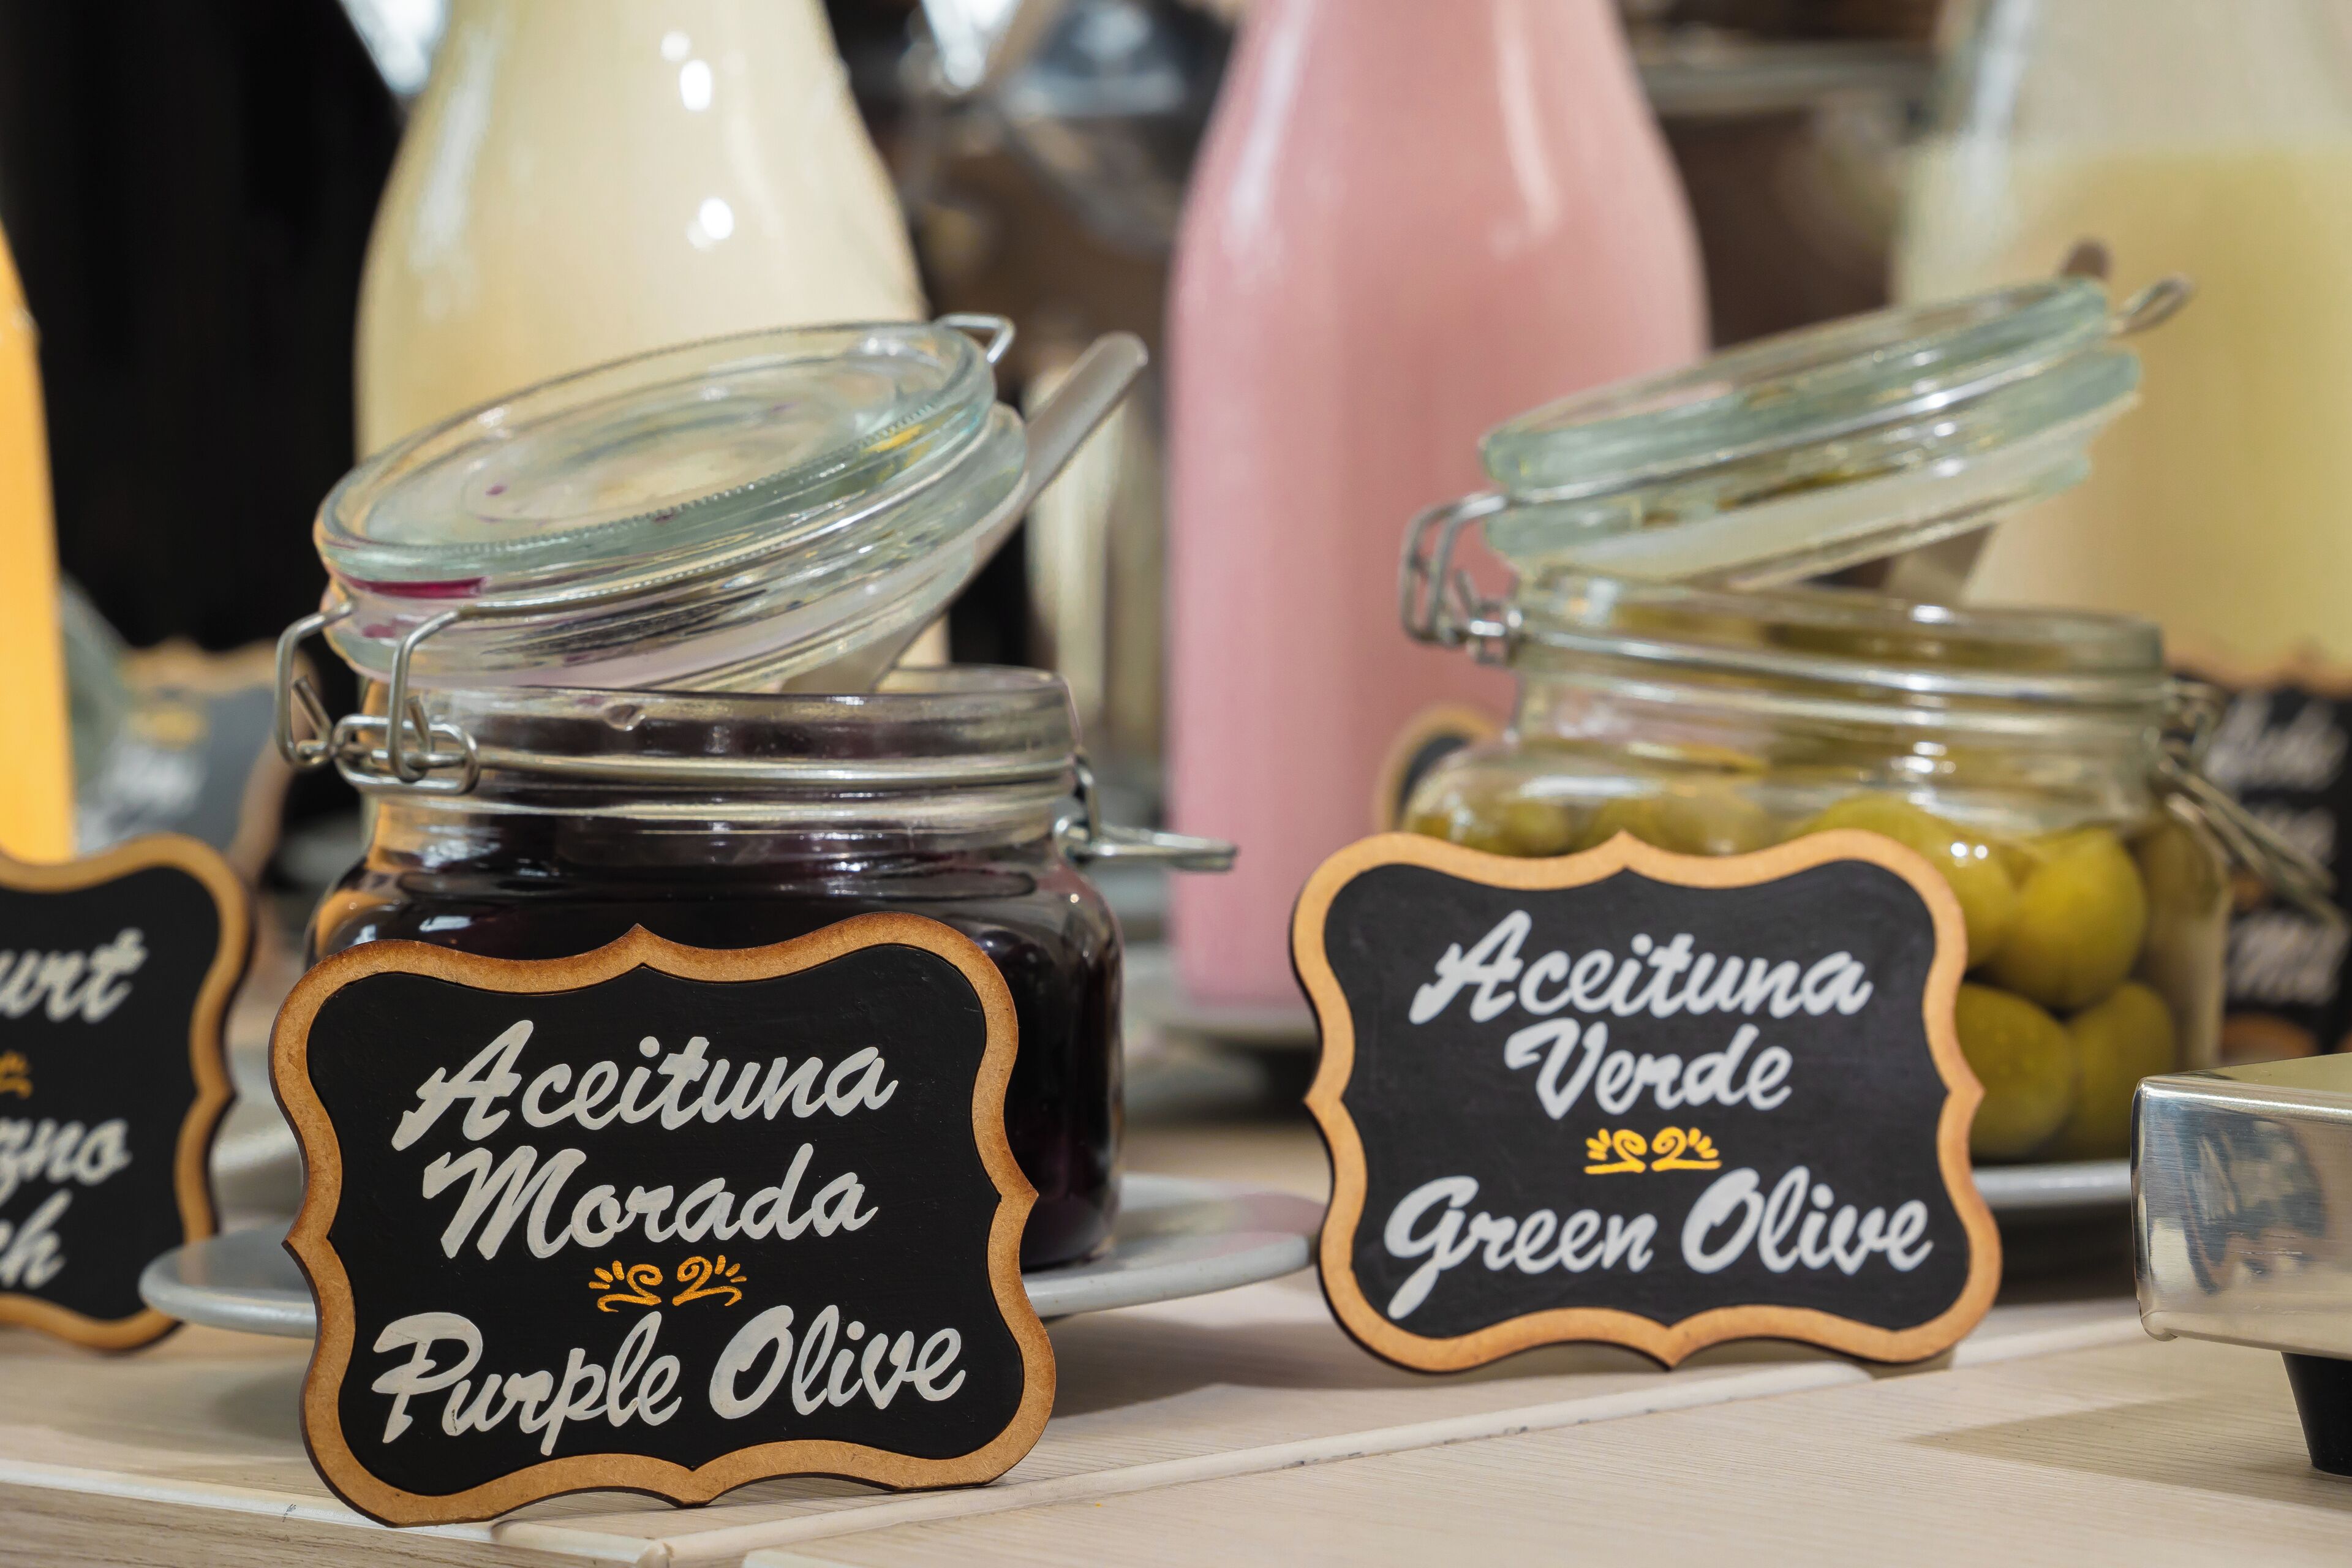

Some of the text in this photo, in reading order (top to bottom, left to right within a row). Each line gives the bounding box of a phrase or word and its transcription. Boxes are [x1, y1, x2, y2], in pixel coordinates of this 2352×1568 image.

[1408, 909, 1874, 1025] Aceituna
[390, 1019, 899, 1152] Aceituna
[1503, 1016, 1794, 1120] Verde
[421, 1142, 879, 1261] Morada
[1383, 1165, 1934, 1320] Green Olive
[371, 1304, 966, 1457] Purple Olive
